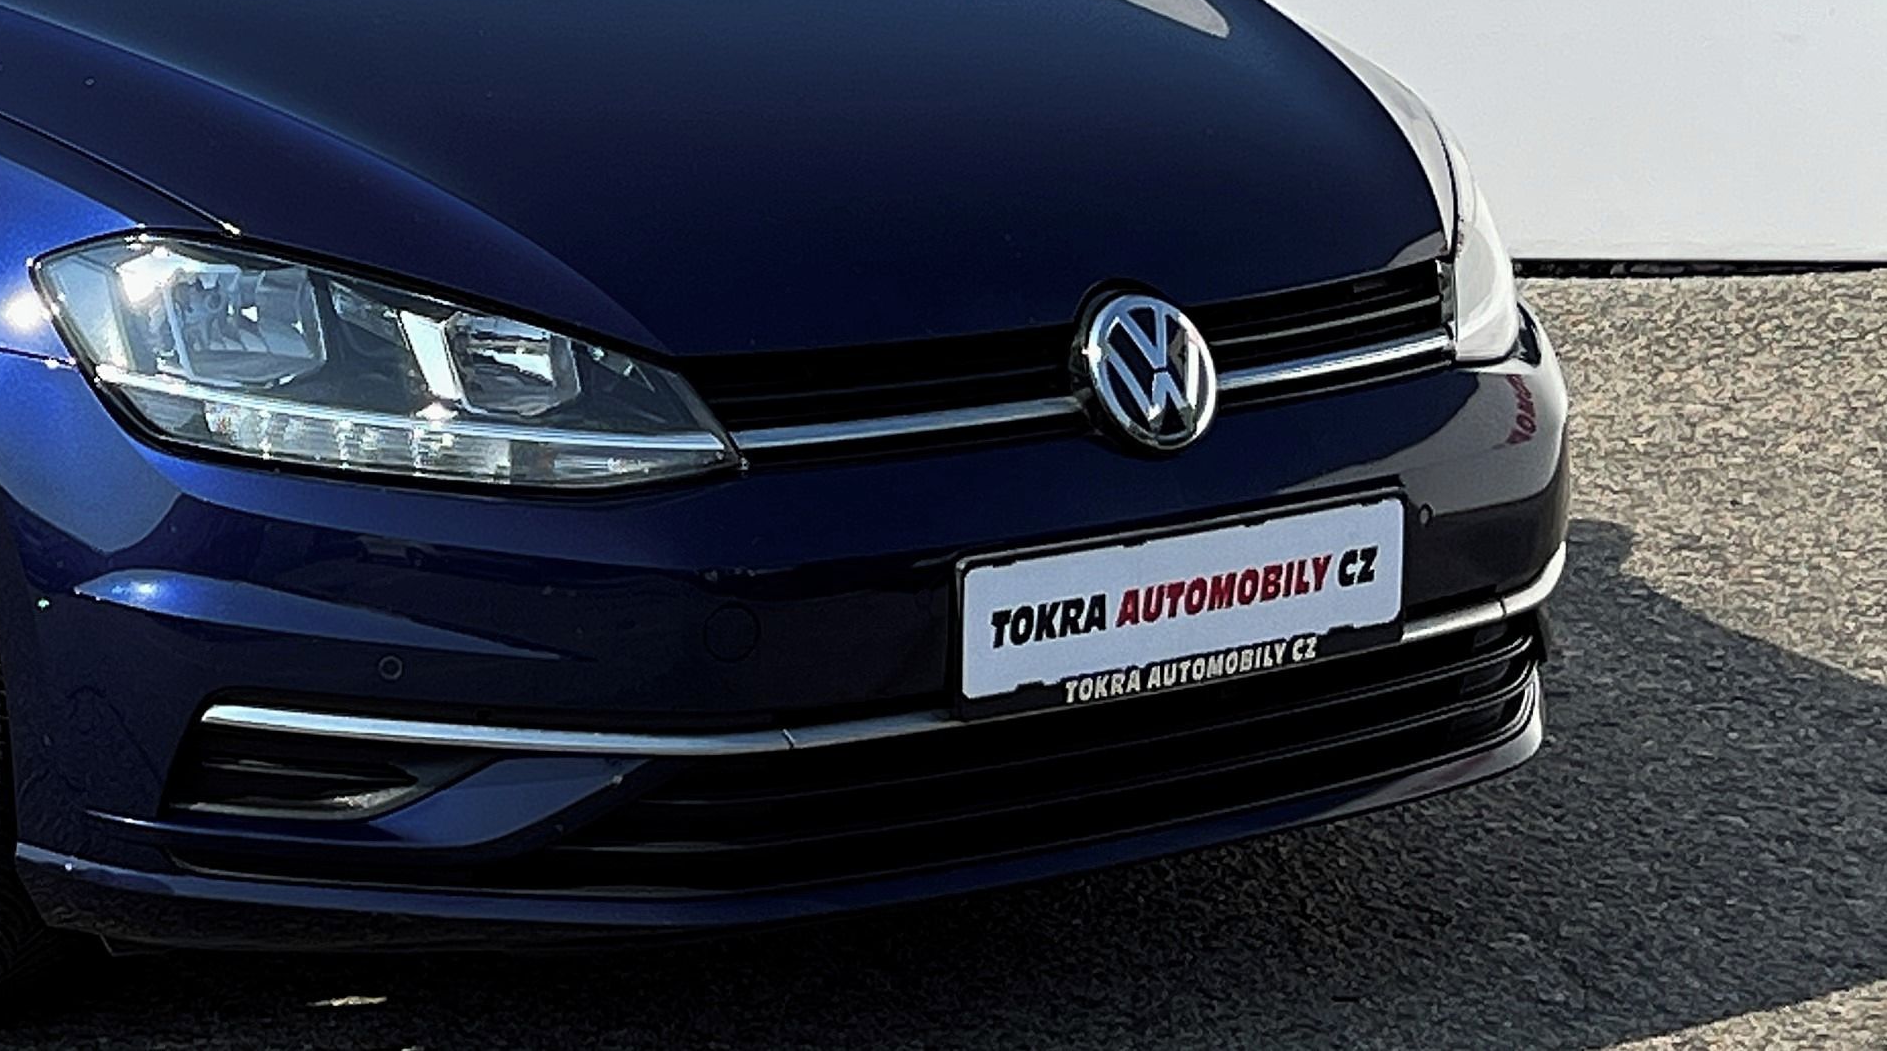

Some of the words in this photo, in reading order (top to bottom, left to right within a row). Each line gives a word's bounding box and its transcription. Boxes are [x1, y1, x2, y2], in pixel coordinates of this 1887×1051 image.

[1090, 295, 1216, 450] VW
[991, 594, 1107, 648] TOKRA
[1116, 554, 1332, 628] AUTOMOBILY
[1338, 546, 1379, 587] CZ
[1065, 670, 1141, 704] TOKRA
[1147, 642, 1286, 689] AUTOMOBILY
[1292, 637, 1317, 663] CZ
